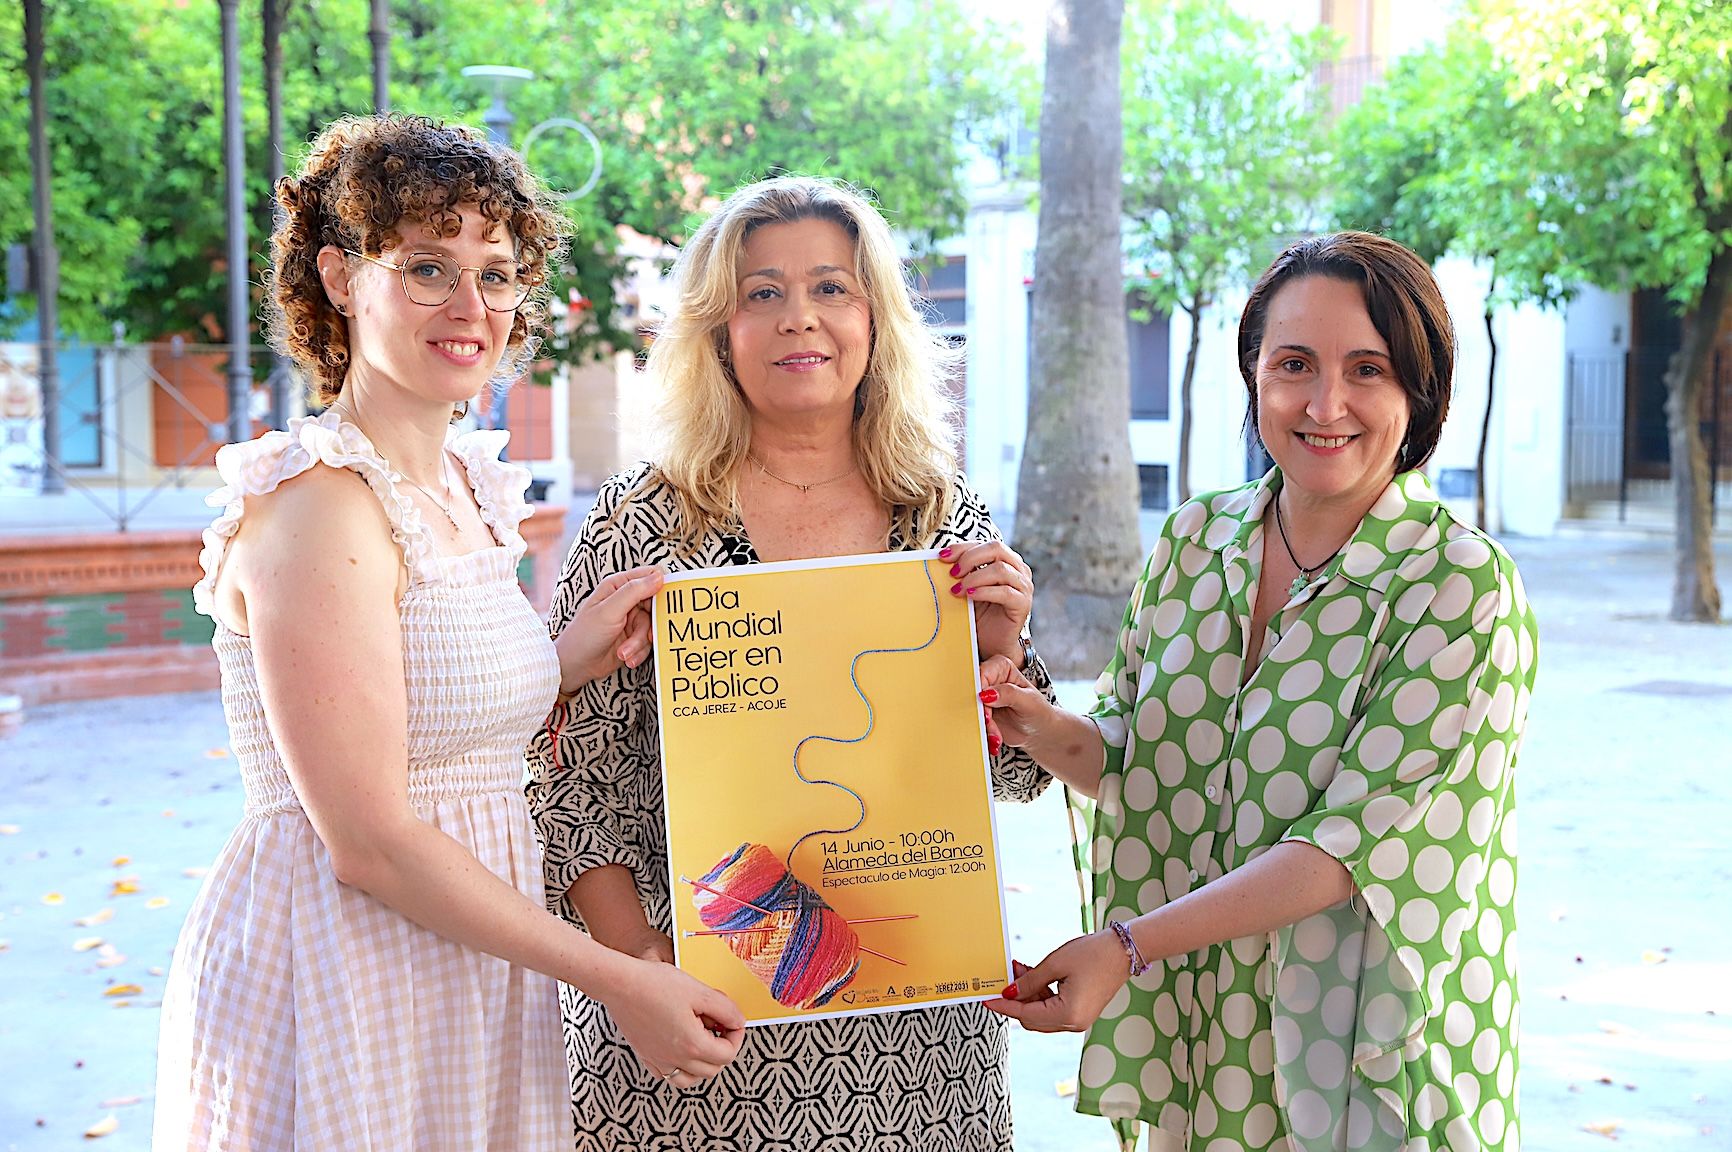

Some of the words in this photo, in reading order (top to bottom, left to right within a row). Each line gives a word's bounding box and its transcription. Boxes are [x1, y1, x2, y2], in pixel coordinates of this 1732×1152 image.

[691, 586, 740, 612] Día
[668, 610, 782, 643] Mundial
[669, 646, 738, 677] Tejer
[745, 646, 782, 667] en
[672, 673, 779, 702] Público
[673, 706, 700, 717] CCA
[703, 703, 737, 715] JEREZ
[747, 699, 787, 711] ACOJE
[821, 842, 838, 855] 14
[842, 838, 885, 854] Junio
[899, 829, 955, 847] 10:00h
[822, 852, 900, 872] Alameda
[902, 848, 927, 863] del
[930, 844, 984, 860] Banco
[822, 872, 890, 888] Espectaculo
[892, 870, 907, 880] de
[909, 867, 947, 880] Magia:
[949, 861, 986, 874] 12:00h
